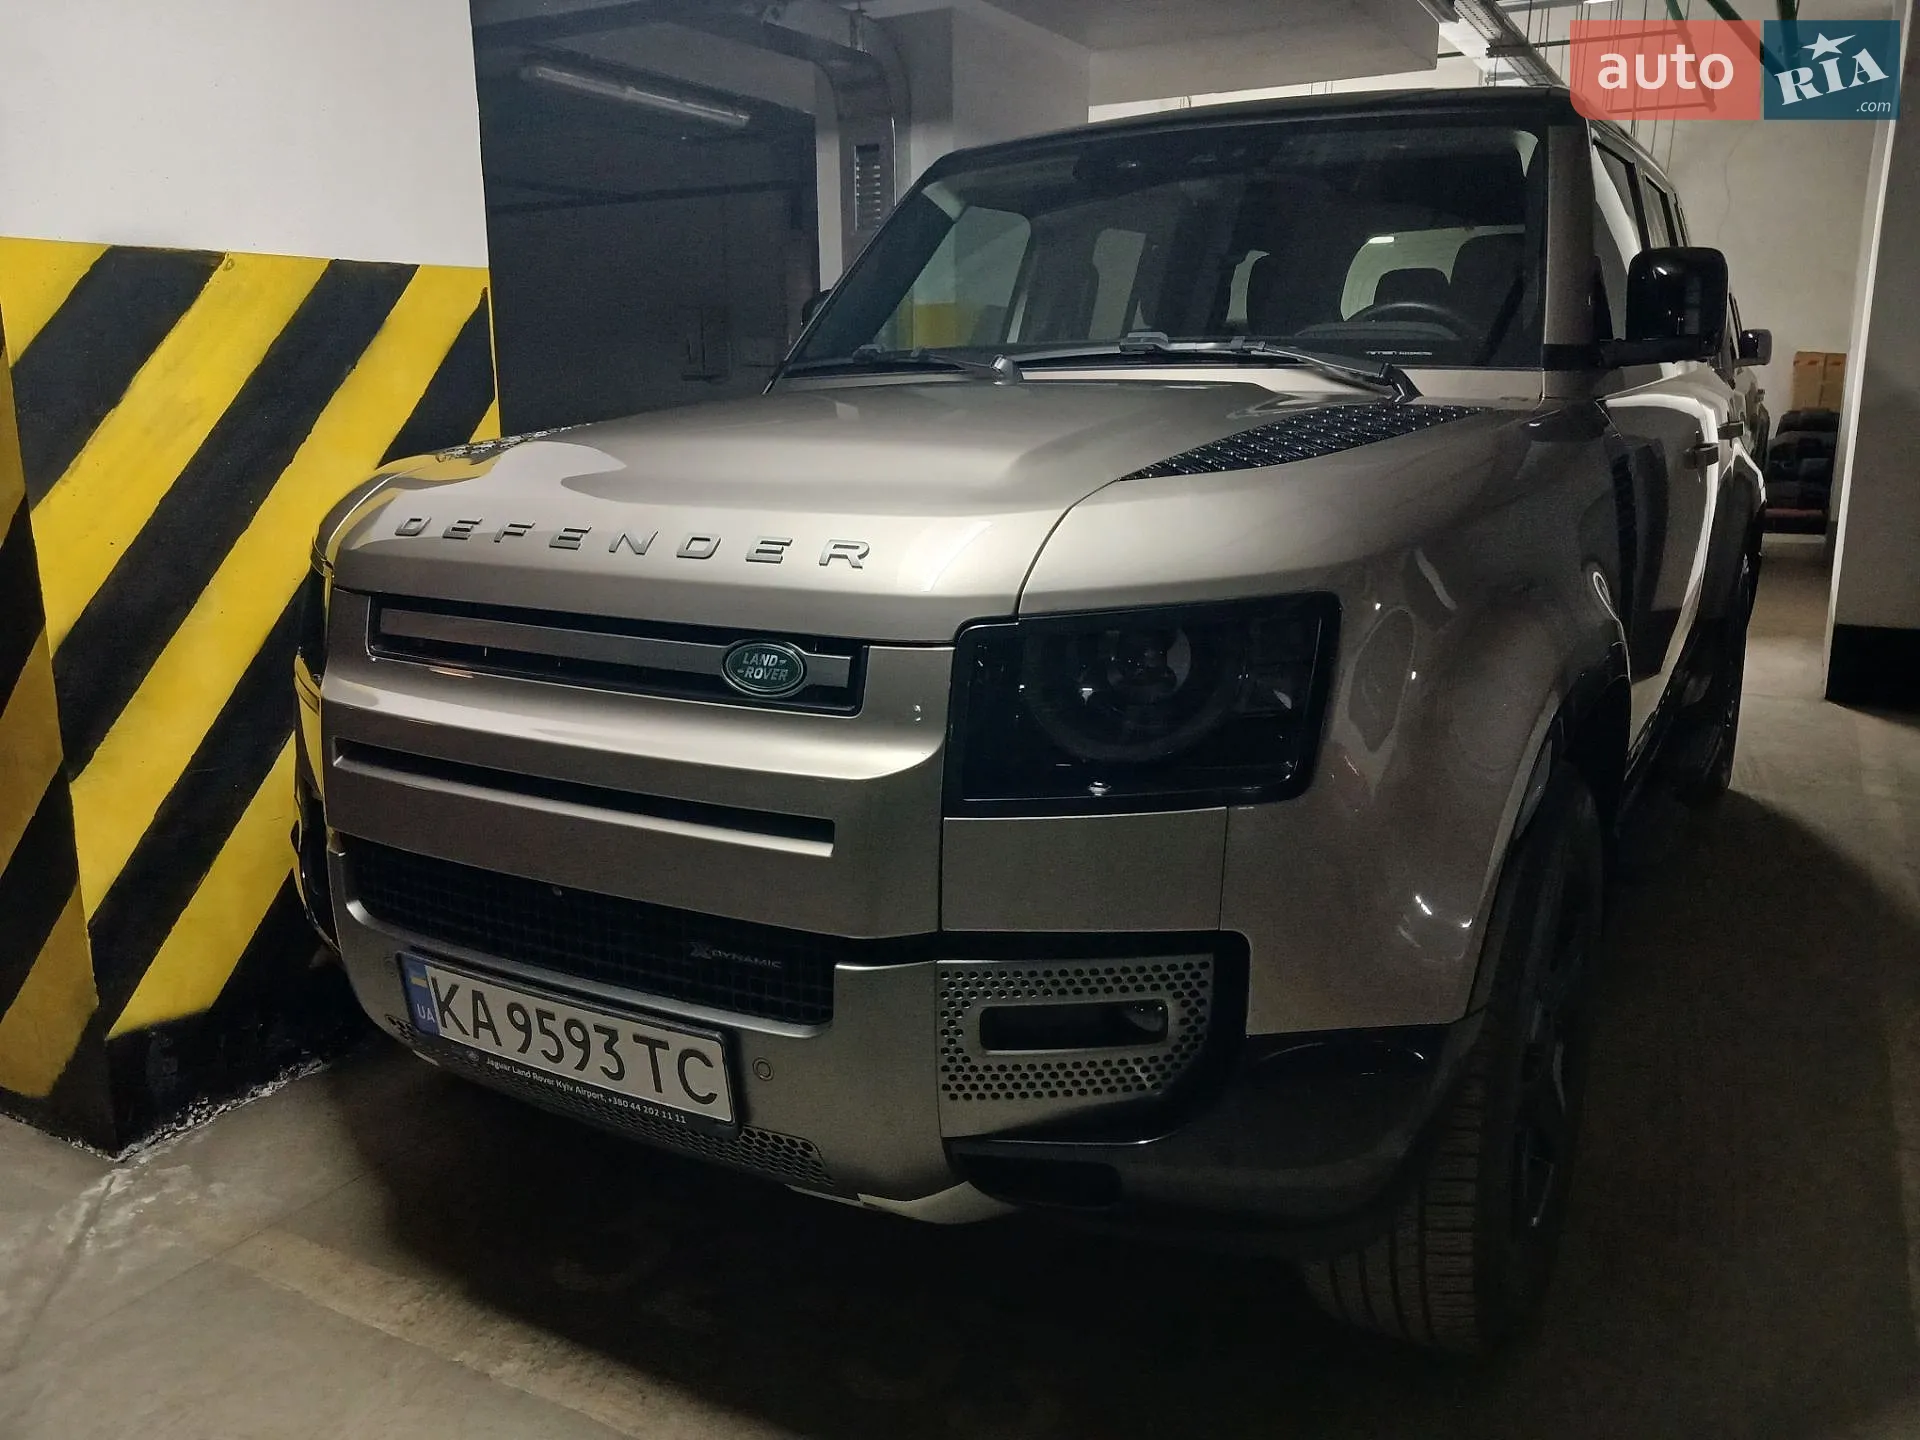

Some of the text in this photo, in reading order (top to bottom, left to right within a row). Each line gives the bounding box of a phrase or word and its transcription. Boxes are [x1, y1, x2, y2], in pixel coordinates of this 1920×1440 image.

[394, 516, 870, 569] DEFENDER
[742, 652, 778, 667] LAND
[744, 665, 788, 681] ROVER
[416, 1003, 435, 1023] UA
[487, 1057, 511, 1072] Jaguar
[512, 1066, 531, 1078] Land
[533, 1072, 554, 1086] Rover
